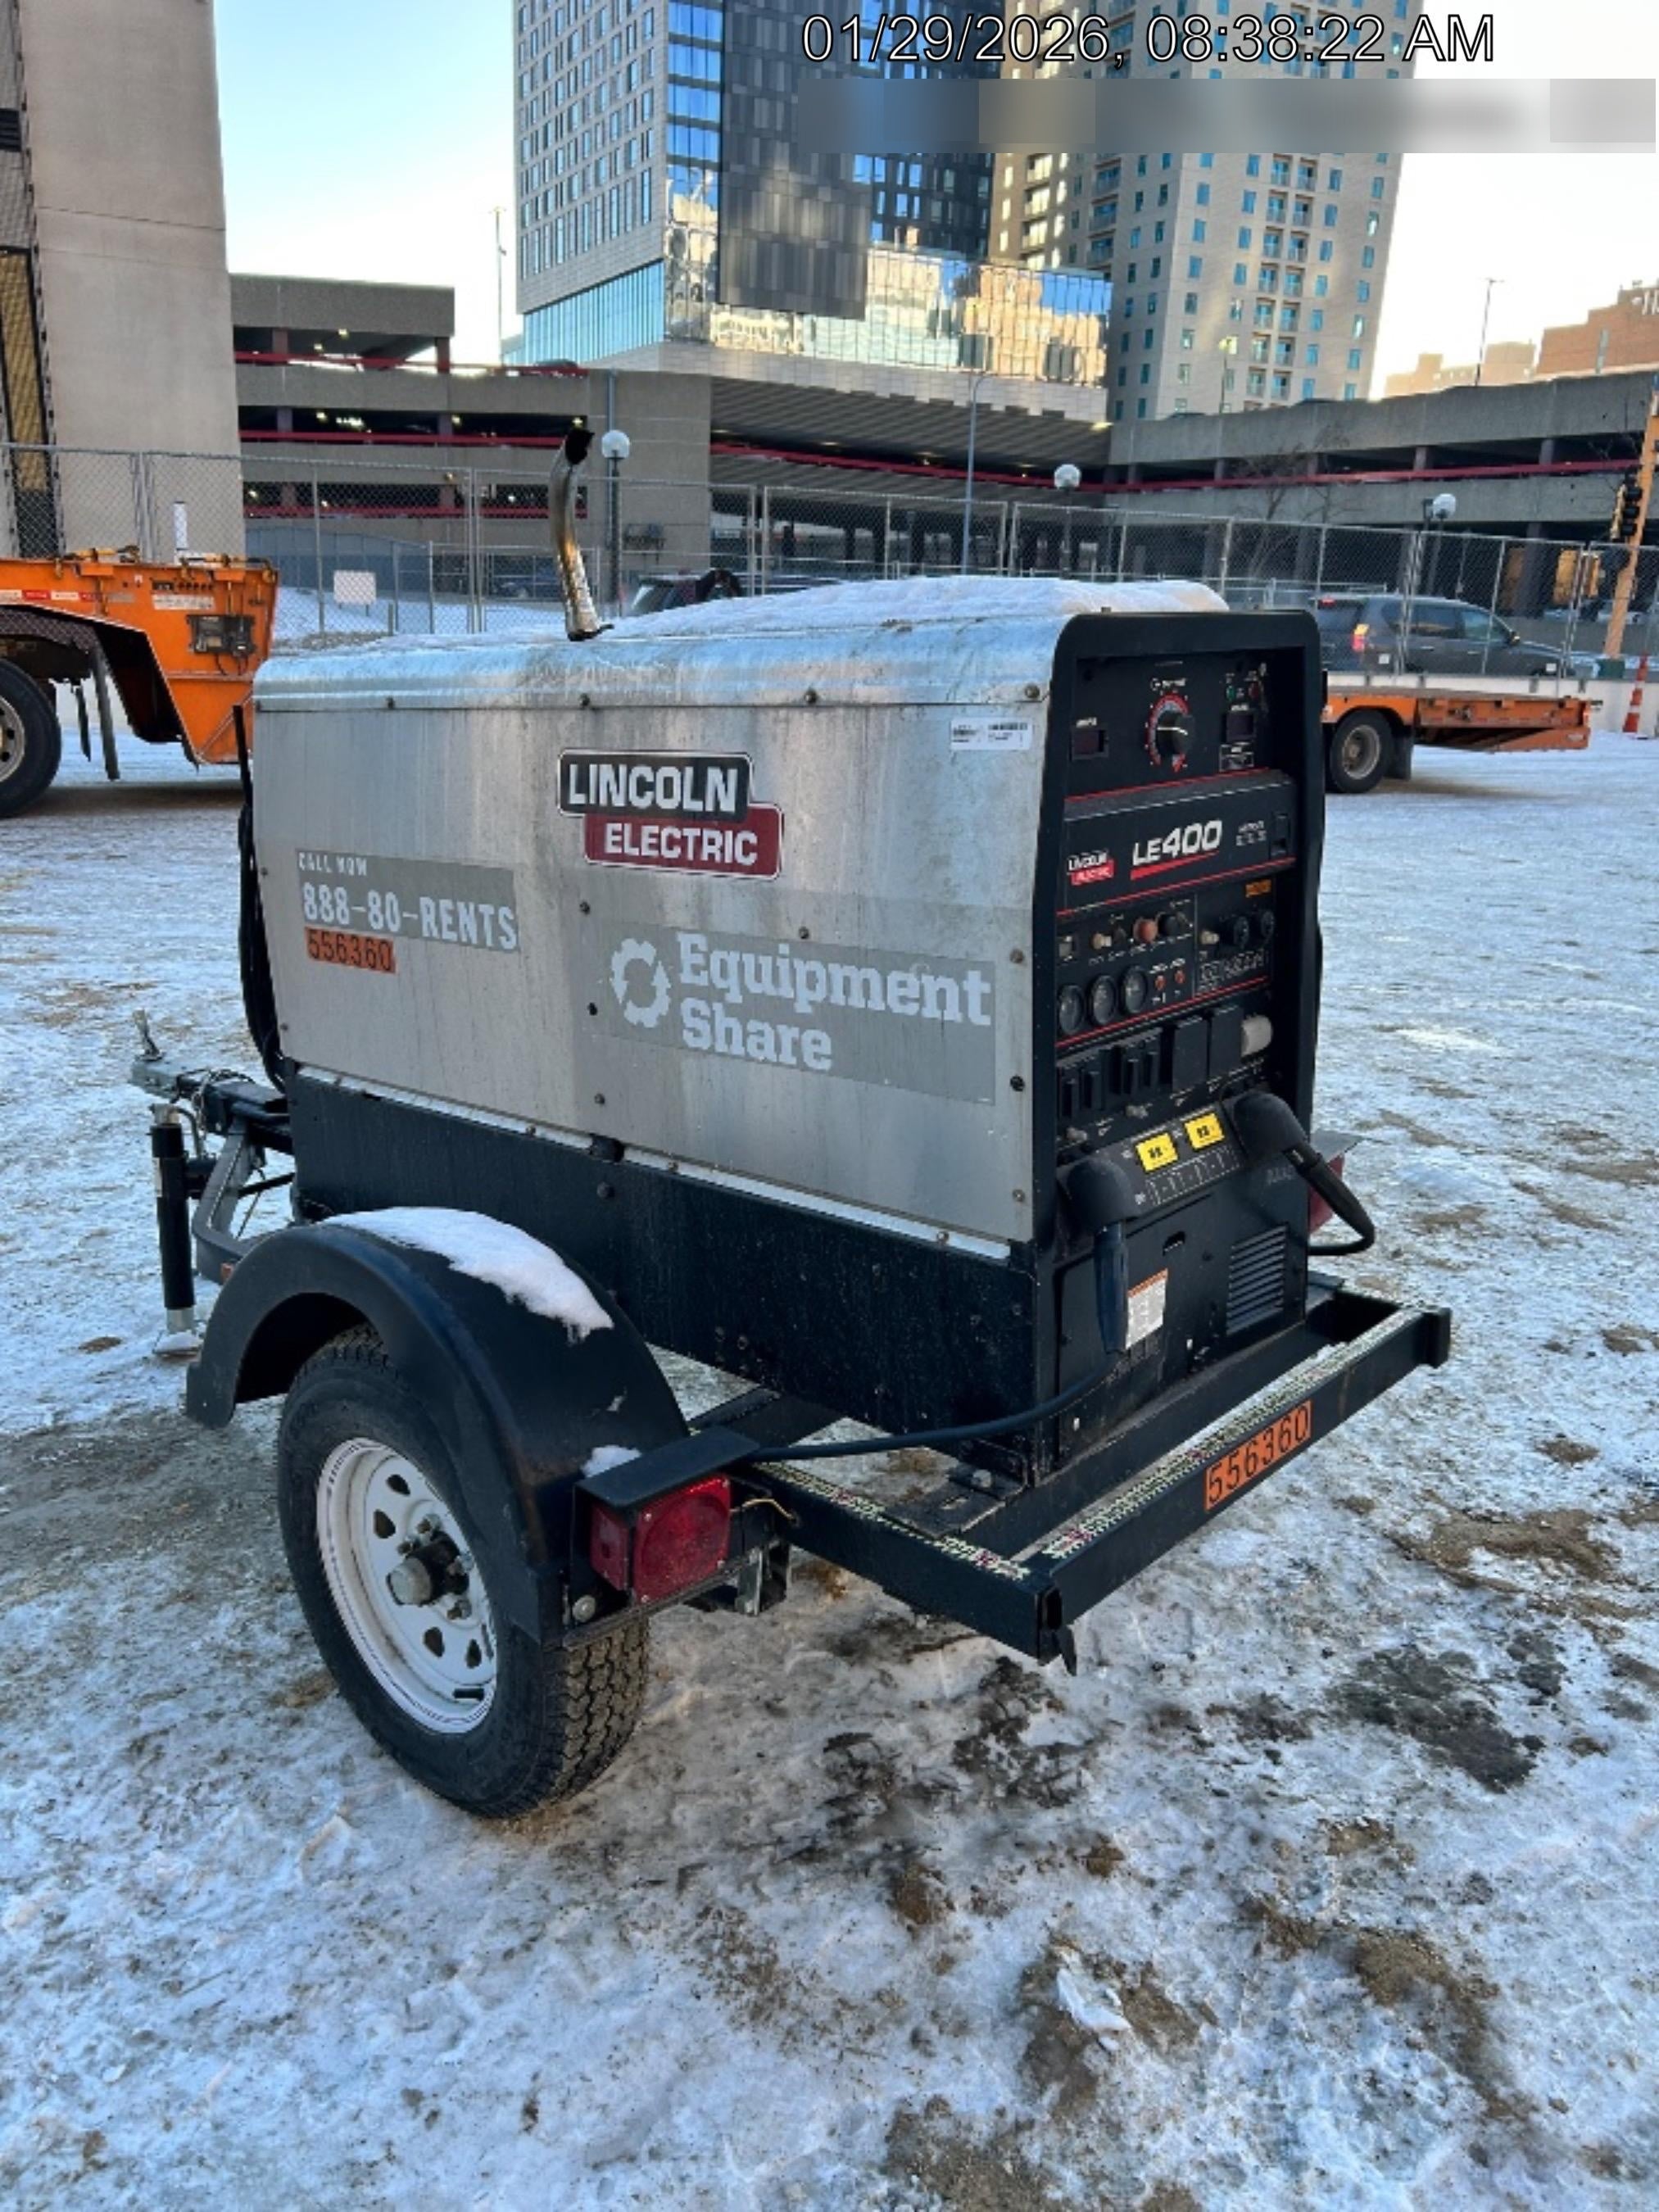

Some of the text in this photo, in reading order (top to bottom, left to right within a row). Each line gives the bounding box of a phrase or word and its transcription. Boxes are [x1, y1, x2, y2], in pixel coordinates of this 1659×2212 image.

[569, 764, 738, 813] LINCOLN
[298, 852, 368, 876] CALL NOW
[605, 823, 758, 866] ELECTRIC
[1132, 820, 1223, 866] LE400
[302, 882, 518, 950] 888-80-RENTS
[308, 928, 392, 972] 556360
[676, 932, 991, 1026] Equipment
[680, 998, 832, 1071] Share
[1209, 1406, 1308, 1503] 556360
